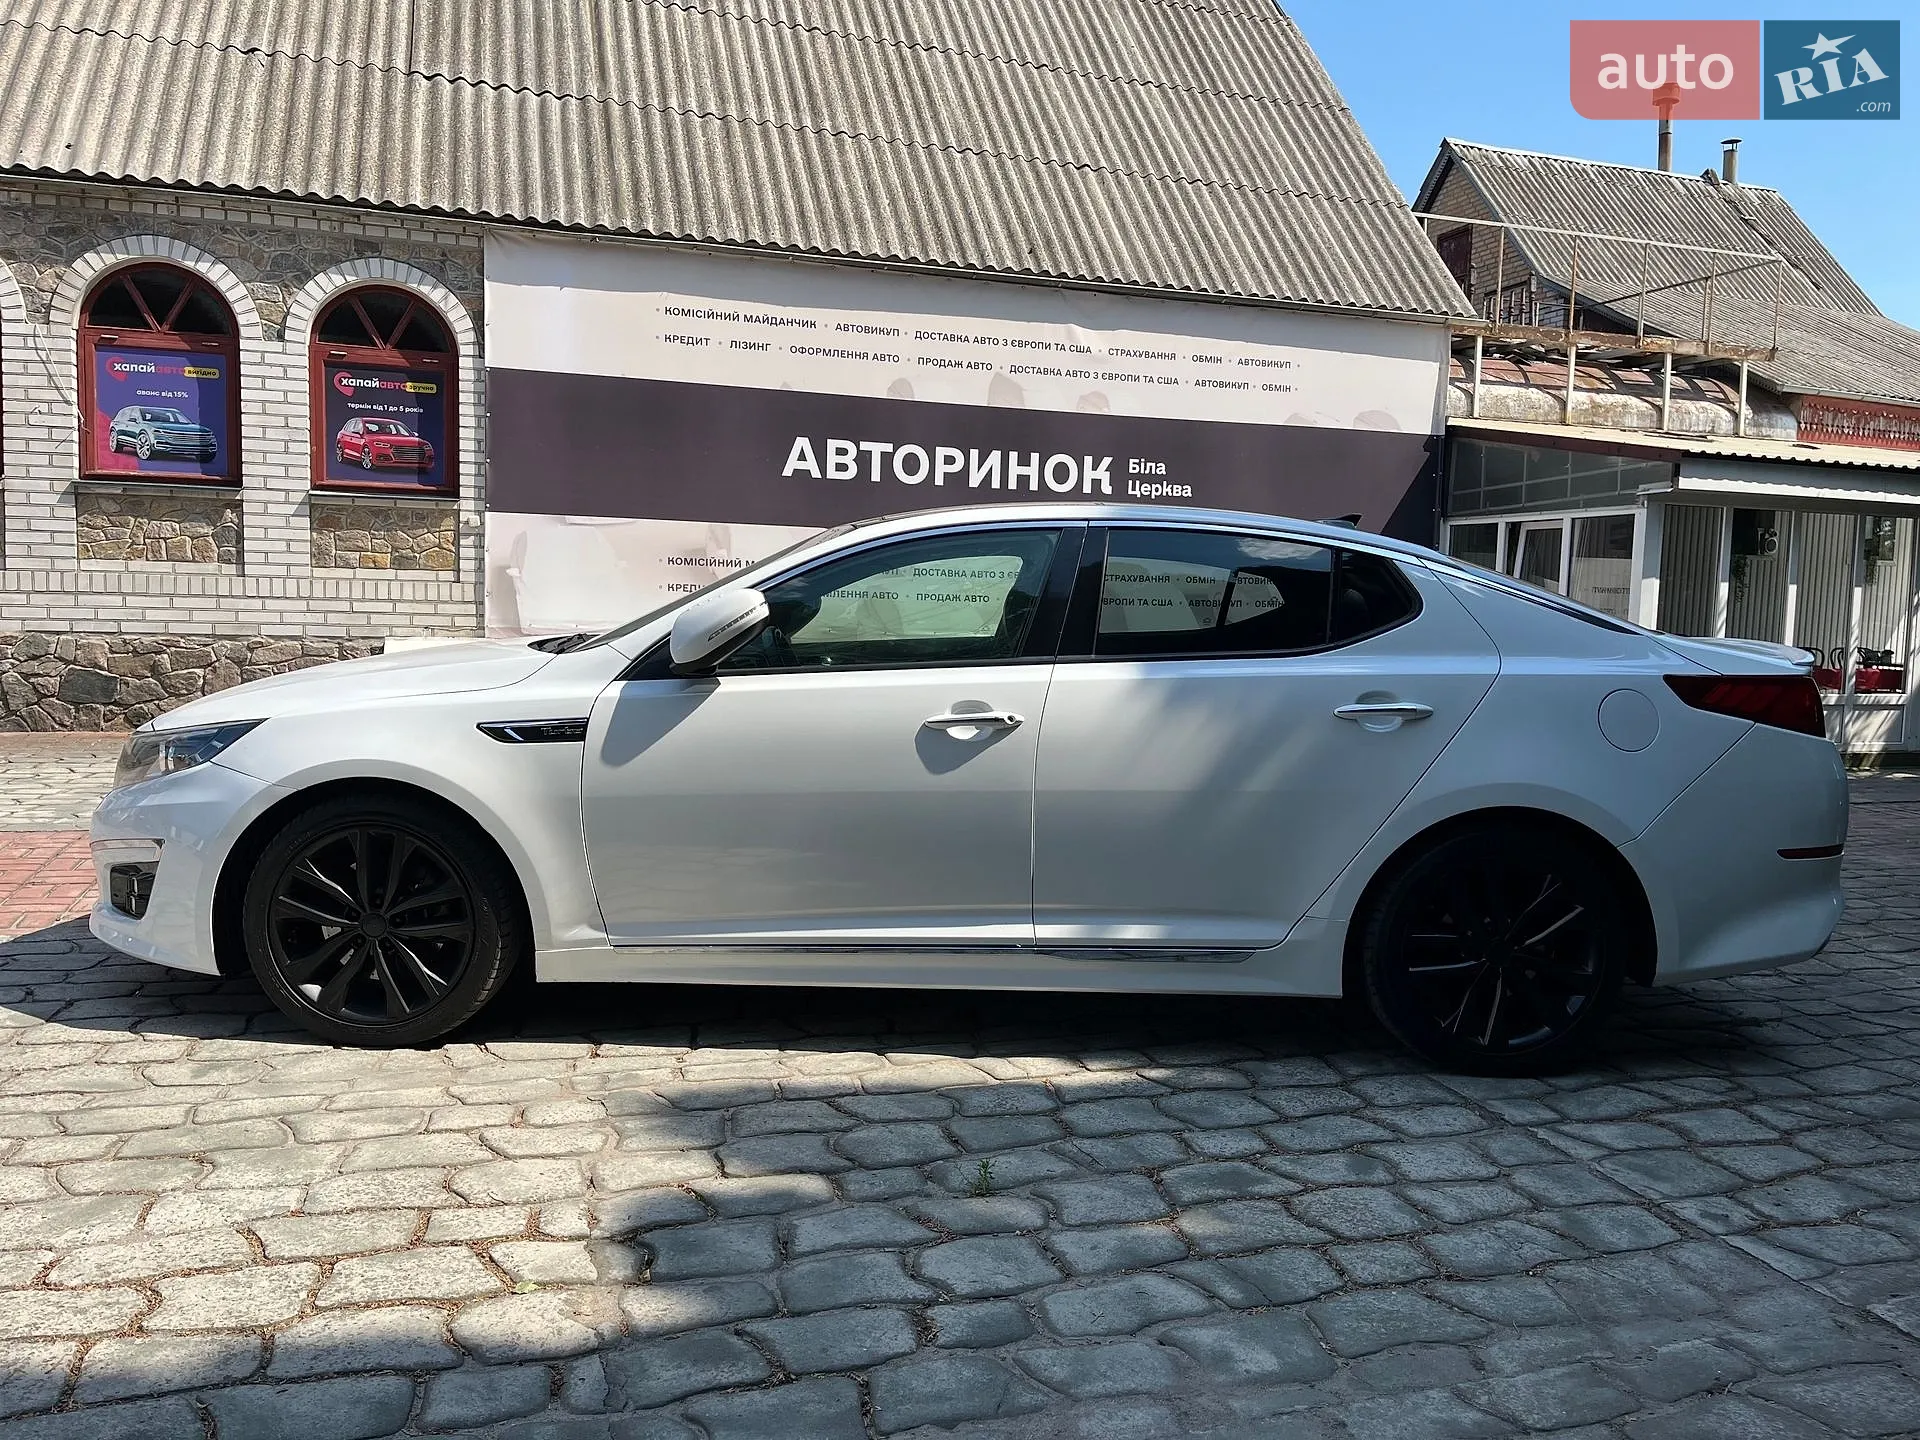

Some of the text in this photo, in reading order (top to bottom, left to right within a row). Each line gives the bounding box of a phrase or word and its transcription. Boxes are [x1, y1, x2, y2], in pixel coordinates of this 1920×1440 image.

[664, 306, 1291, 369] КОМІСІЙНИЙ МАЙДАНЧИК АВТОВИКУП ДОСТАВКА АВТО З ЄВРОПИ ТА США СТРАХУВАННЯ ОБМІН АВТОВИКУП
[664, 333, 1292, 393] КРЕДИТ ЛІЗИНГ ОФОРМЛЕННЯ АВТО ПРОДАЖ АВТО ДОСТАВКА АВТО З ЄВРОПИ ТА США АВТОВИКУП ОБМІН
[136, 389, 160, 397] аванс
[347, 402, 371, 410] термін
[781, 436, 1113, 496] АВТОРИНОК
[1128, 457, 1167, 476] Біла
[1127, 479, 1193, 500] Церква
[667, 556, 742, 568] КОМІСІЙНИЙ
[913, 568, 967, 579] ДОСТАВКА
[970, 570, 996, 579] АВТО
[1104, 574, 1170, 584] СТРАХУВАННЯ
[1185, 576, 1216, 585] ОБМІН
[872, 591, 899, 600] АВТО
[916, 593, 961, 603] ПРОДАЖ
[964, 594, 990, 603] АВТО
[1103, 598, 1135, 607] ВРОПИ
[1137, 599, 1149, 607] ТА
